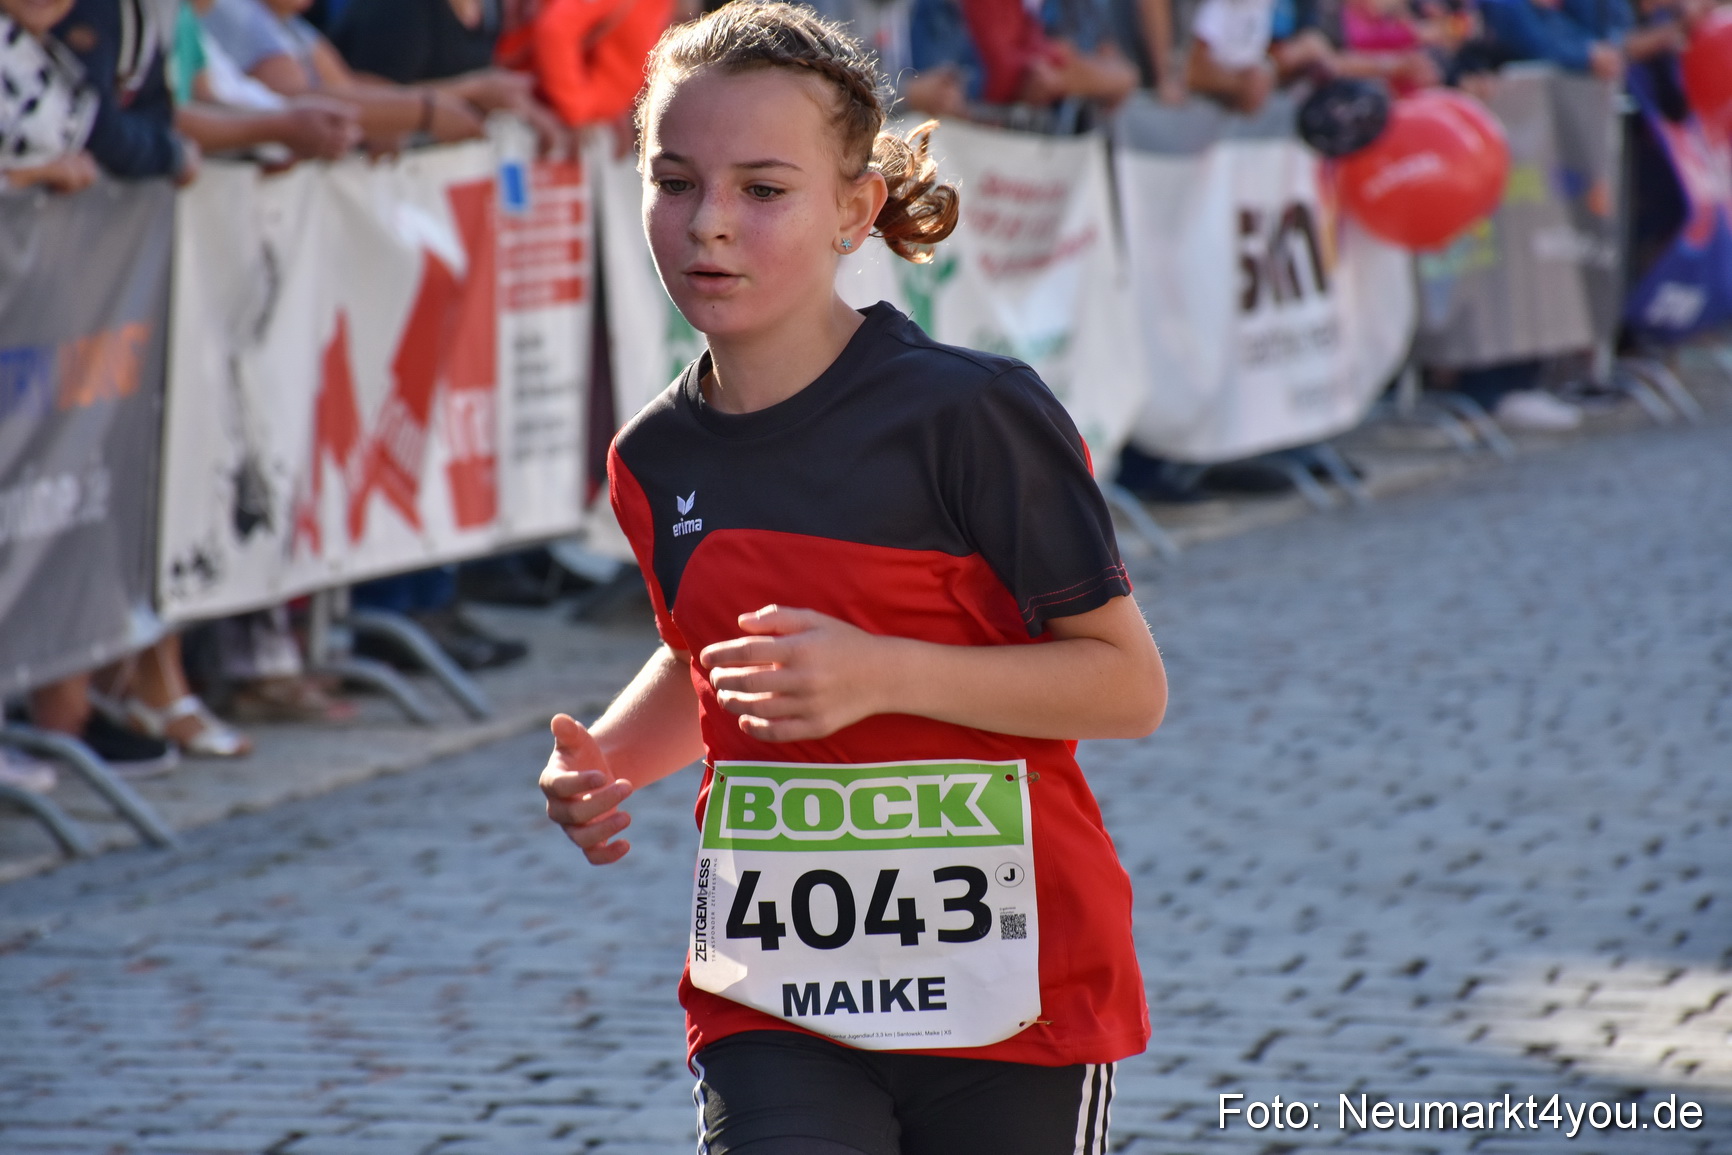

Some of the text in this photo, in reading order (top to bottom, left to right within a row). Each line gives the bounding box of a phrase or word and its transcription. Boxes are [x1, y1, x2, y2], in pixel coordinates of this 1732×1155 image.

[673, 518, 702, 537] erima
[721, 777, 996, 837] BOCK
[1003, 868, 1016, 882] J
[726, 865, 993, 951] 4043
[782, 976, 948, 1017] MAIKE
